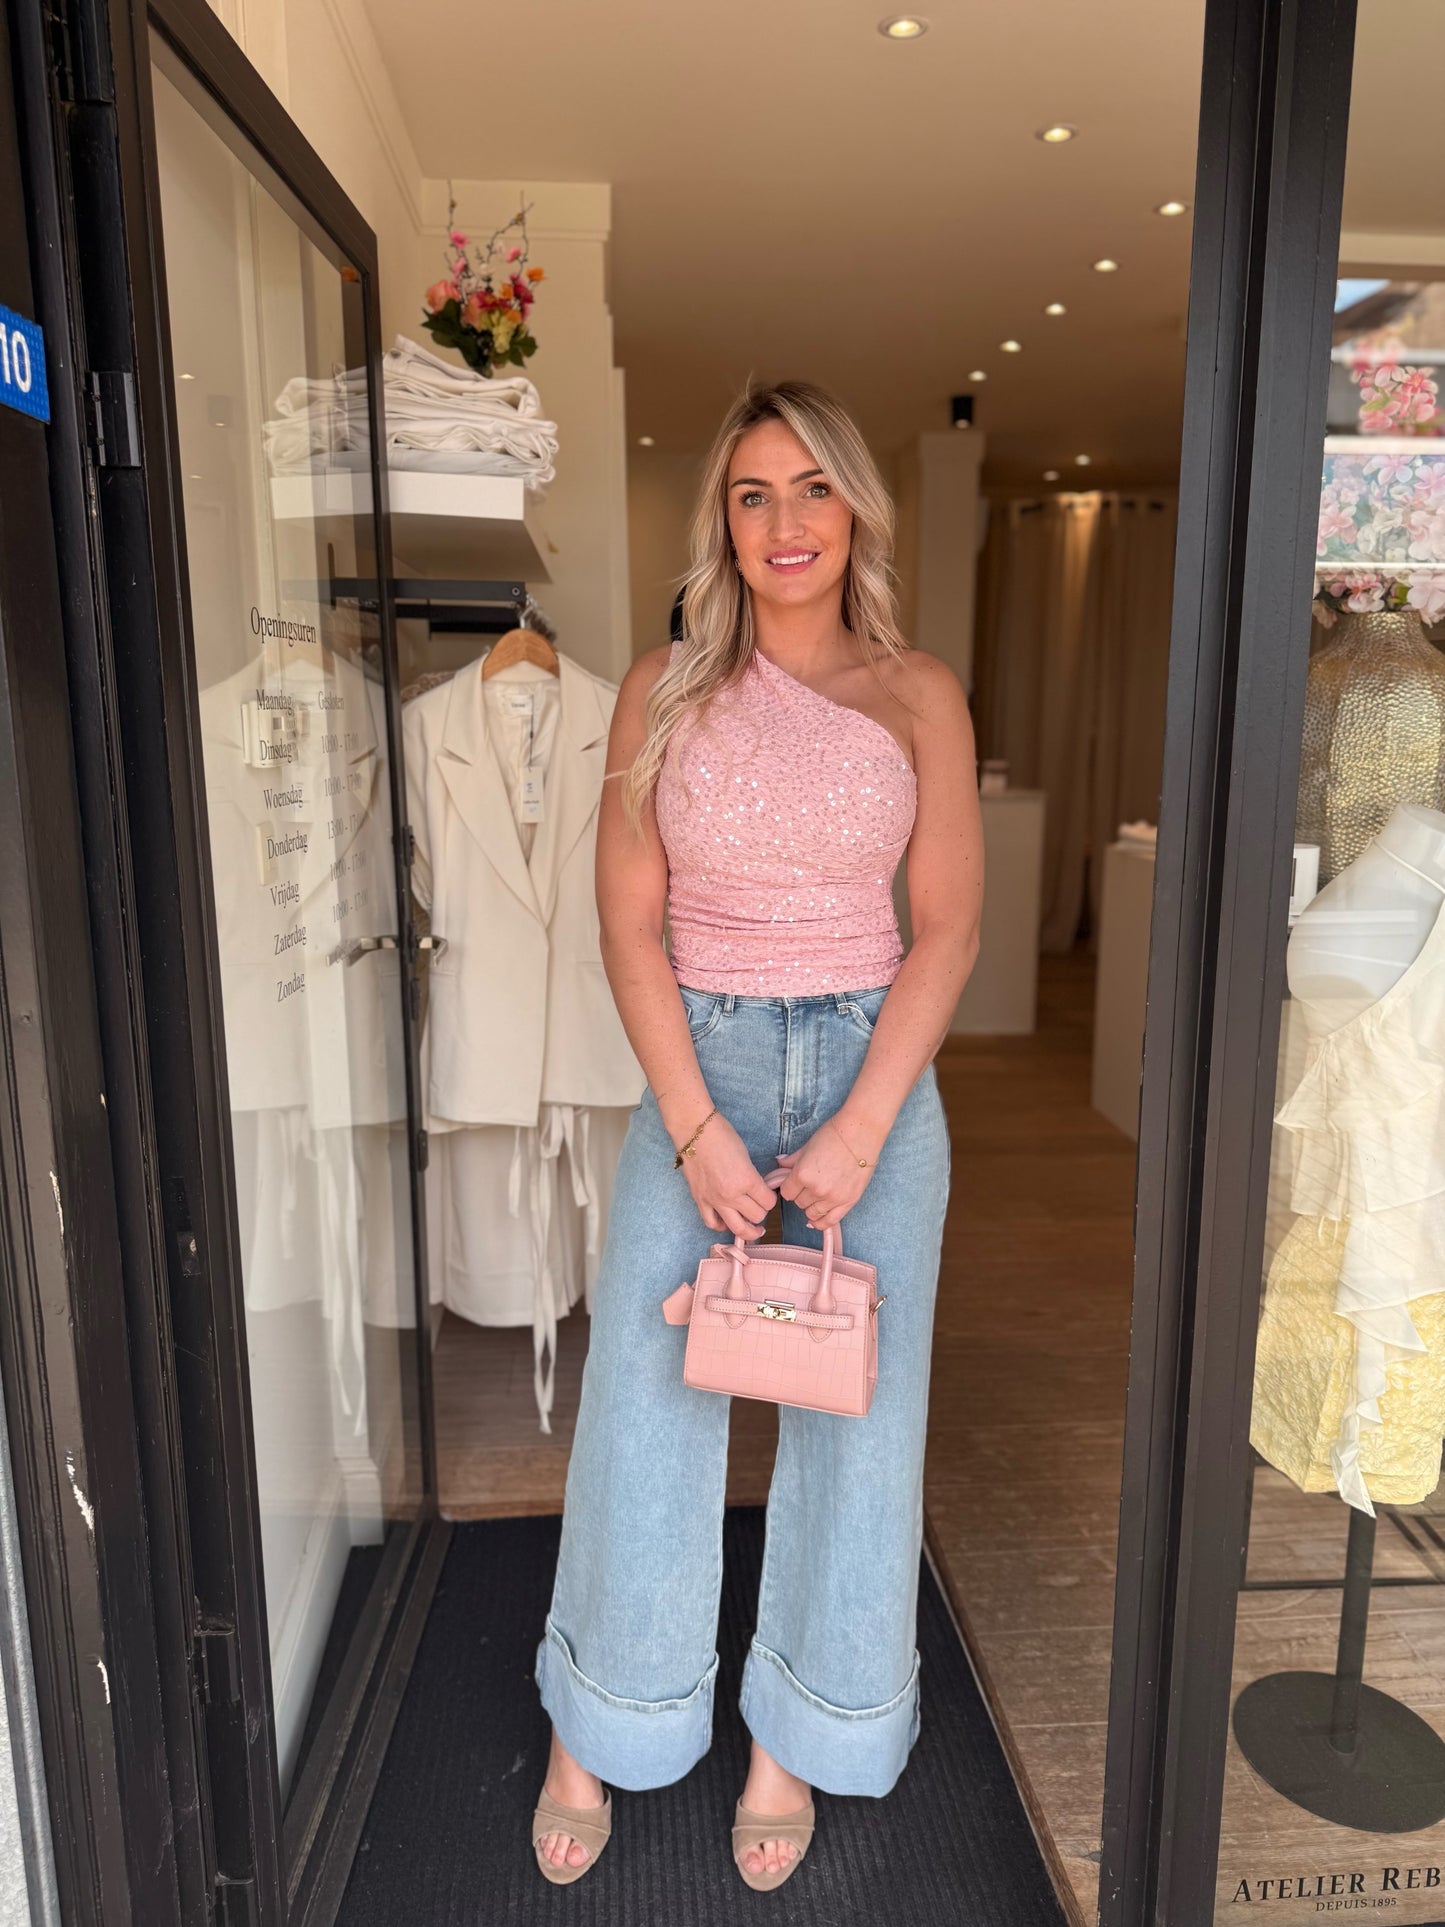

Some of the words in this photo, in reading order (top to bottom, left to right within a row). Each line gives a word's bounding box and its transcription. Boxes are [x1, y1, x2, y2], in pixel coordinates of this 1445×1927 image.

[250, 606, 317, 647] Openingsuren
[256, 689, 294, 716] Maandag
[259, 738, 293, 764] Dinsdag
[263, 784, 303, 808] Woensdag
[267, 830, 308, 860] Donderdag
[270, 881, 300, 909] Vrijdag
[273, 924, 307, 956] Zaterdag
[277, 972, 306, 1003] Zondag
[1231, 1872, 1366, 1903] ATELIER
[1380, 1866, 1444, 1892] REB
[1314, 1898, 1368, 1912] DEPUIS
[1371, 1897, 1398, 1908] 1895
